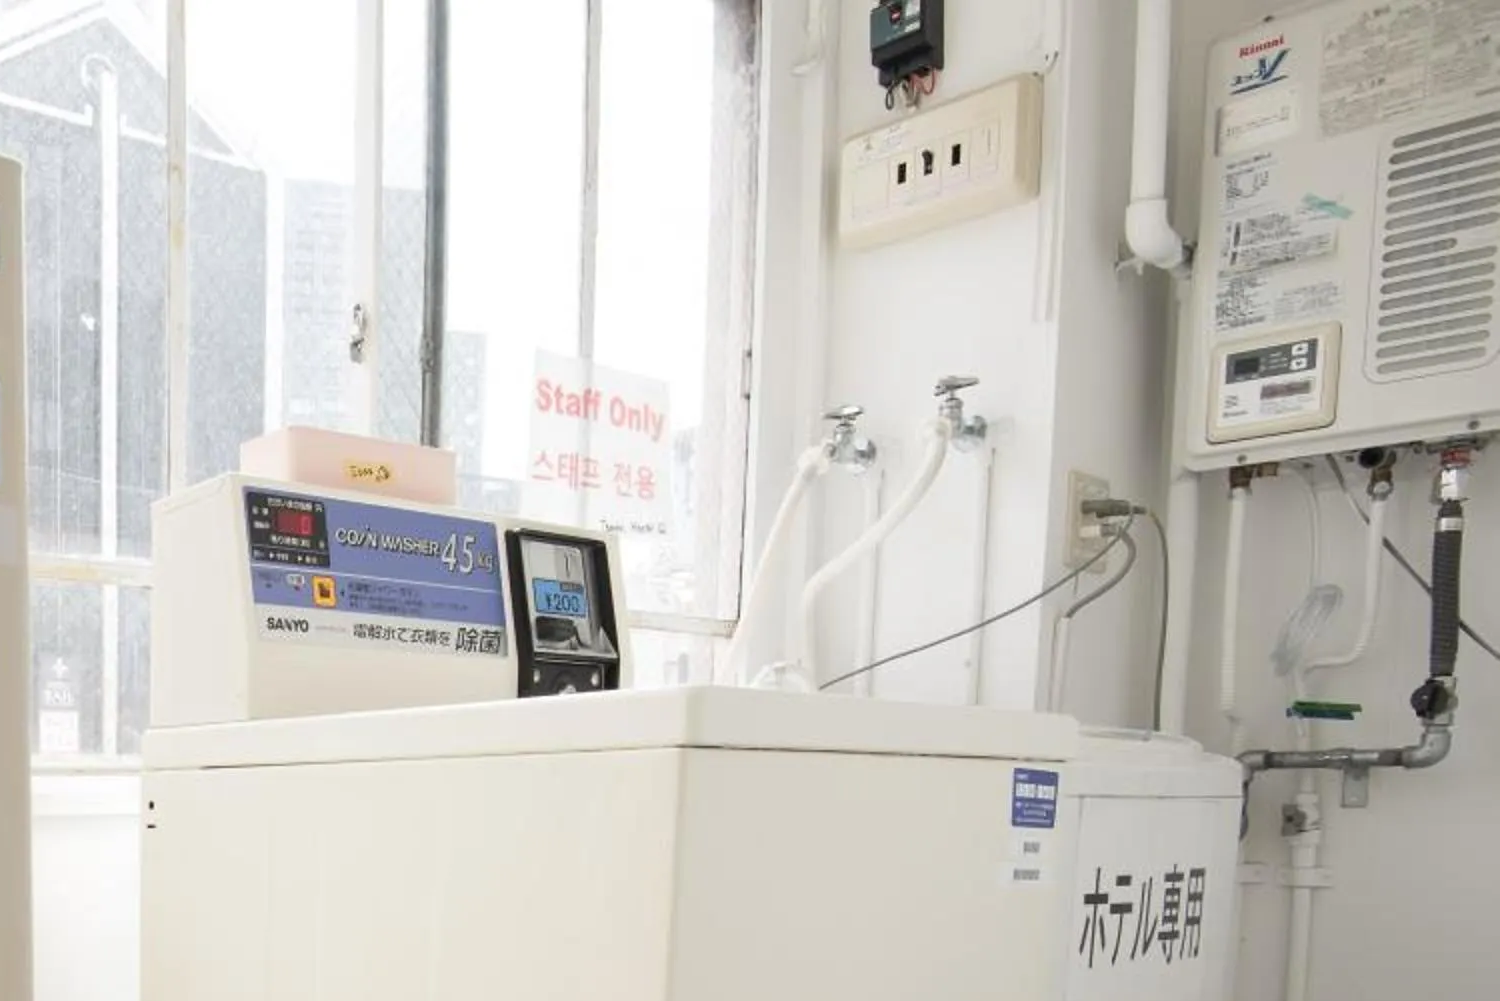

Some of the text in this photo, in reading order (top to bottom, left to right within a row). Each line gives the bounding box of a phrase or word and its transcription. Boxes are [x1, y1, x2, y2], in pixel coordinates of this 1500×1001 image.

[535, 380, 666, 443] Staff Only
[335, 527, 379, 549] COIN
[381, 534, 439, 557] WASHER
[266, 617, 309, 634] SANYO
[1079, 863, 1206, 969] ホテル専用
